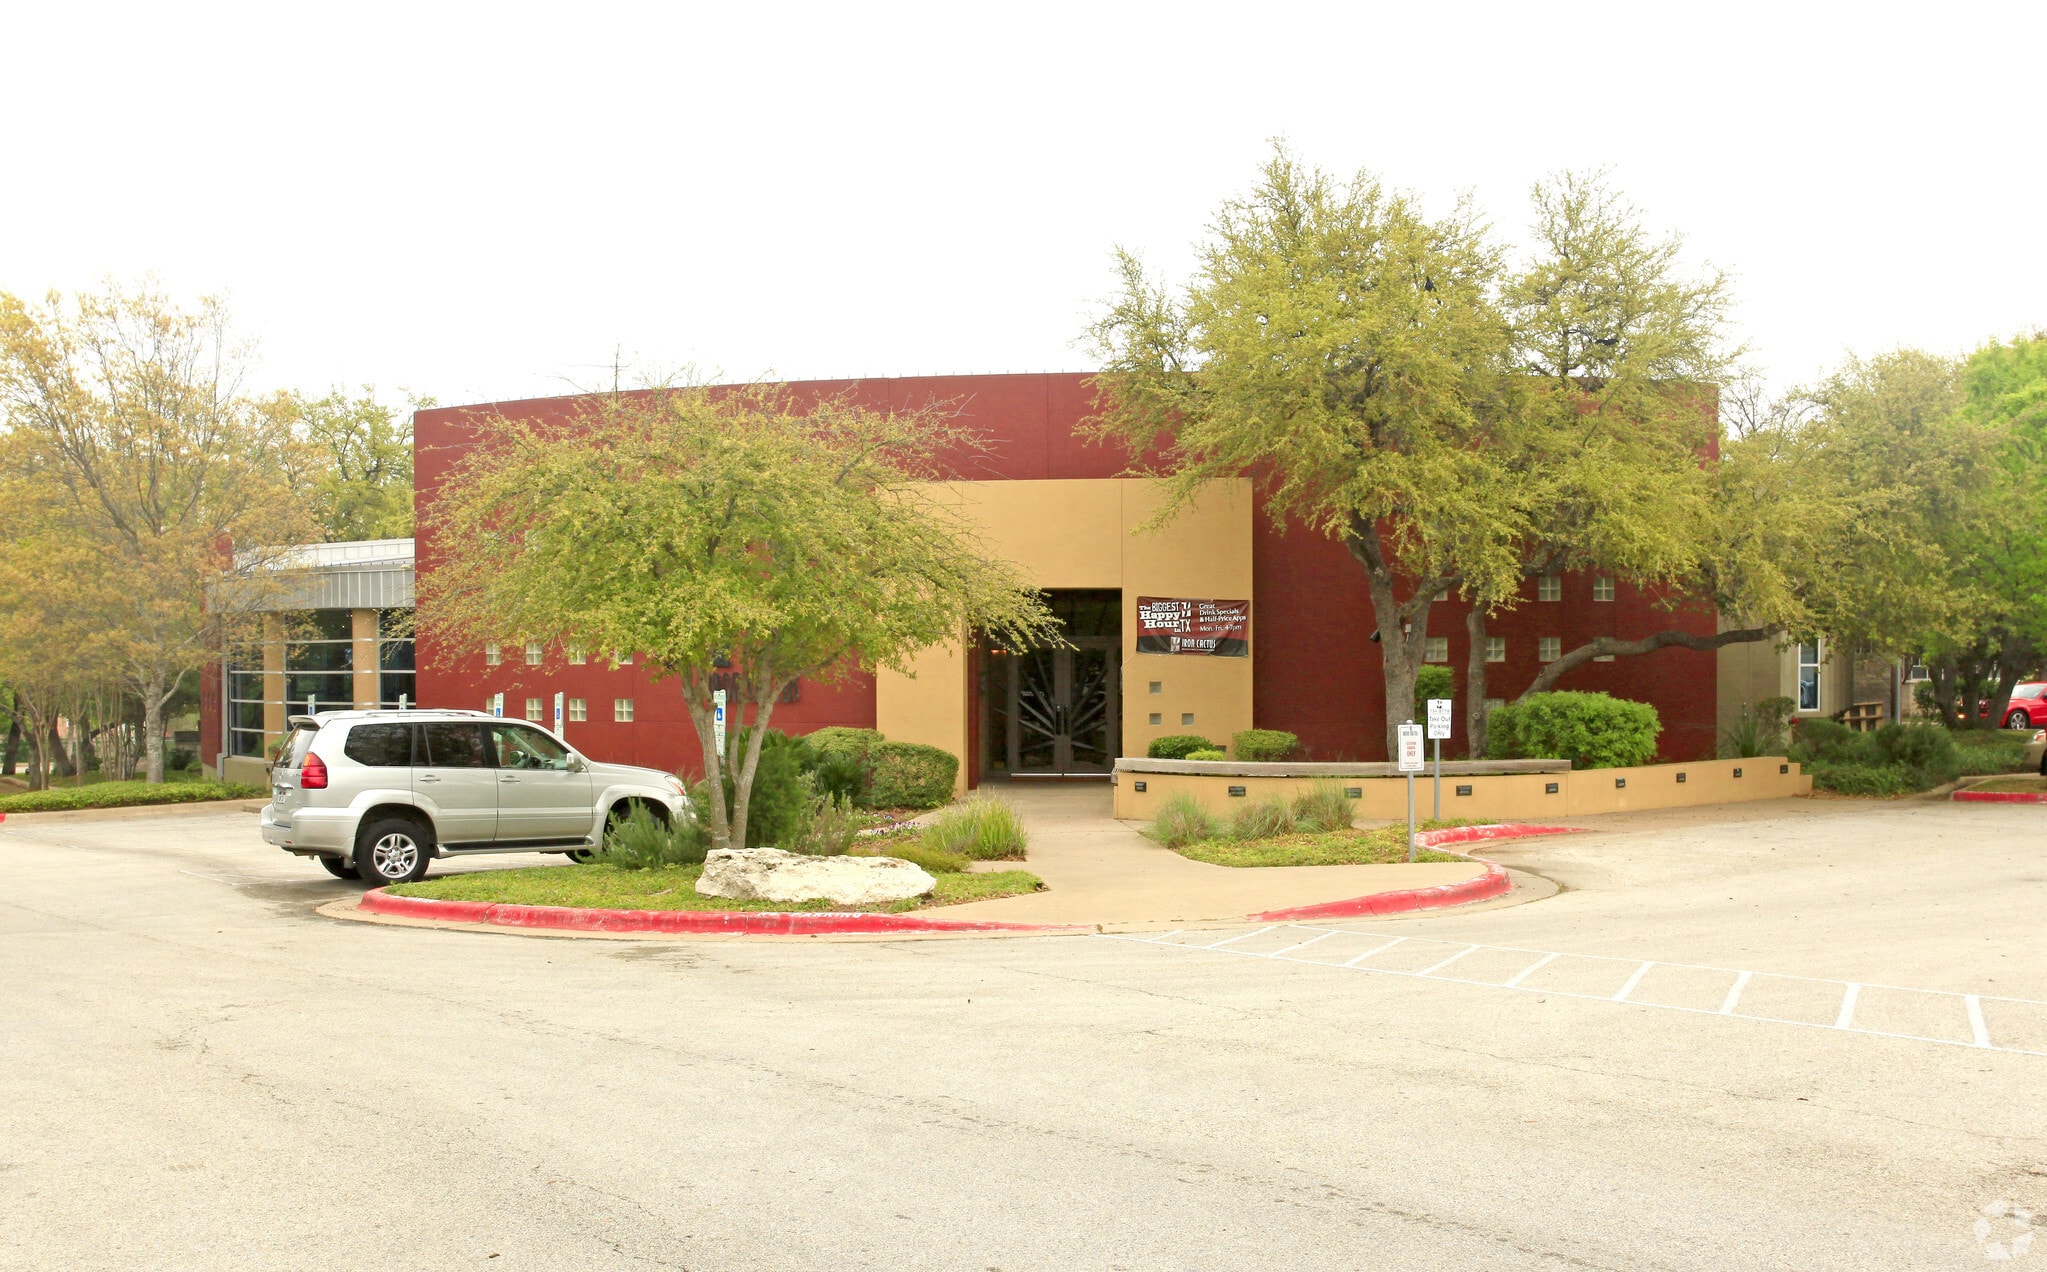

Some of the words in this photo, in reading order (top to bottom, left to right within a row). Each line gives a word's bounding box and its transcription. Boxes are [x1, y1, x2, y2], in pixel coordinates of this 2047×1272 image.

[1151, 602, 1179, 611] BIGGEST
[1140, 611, 1181, 621] Happy
[1217, 608, 1239, 616] Specials
[1144, 620, 1179, 628] Hour
[1180, 619, 1191, 633] TX
[1182, 638, 1195, 648] IRON
[1196, 639, 1216, 648] CACTUS
